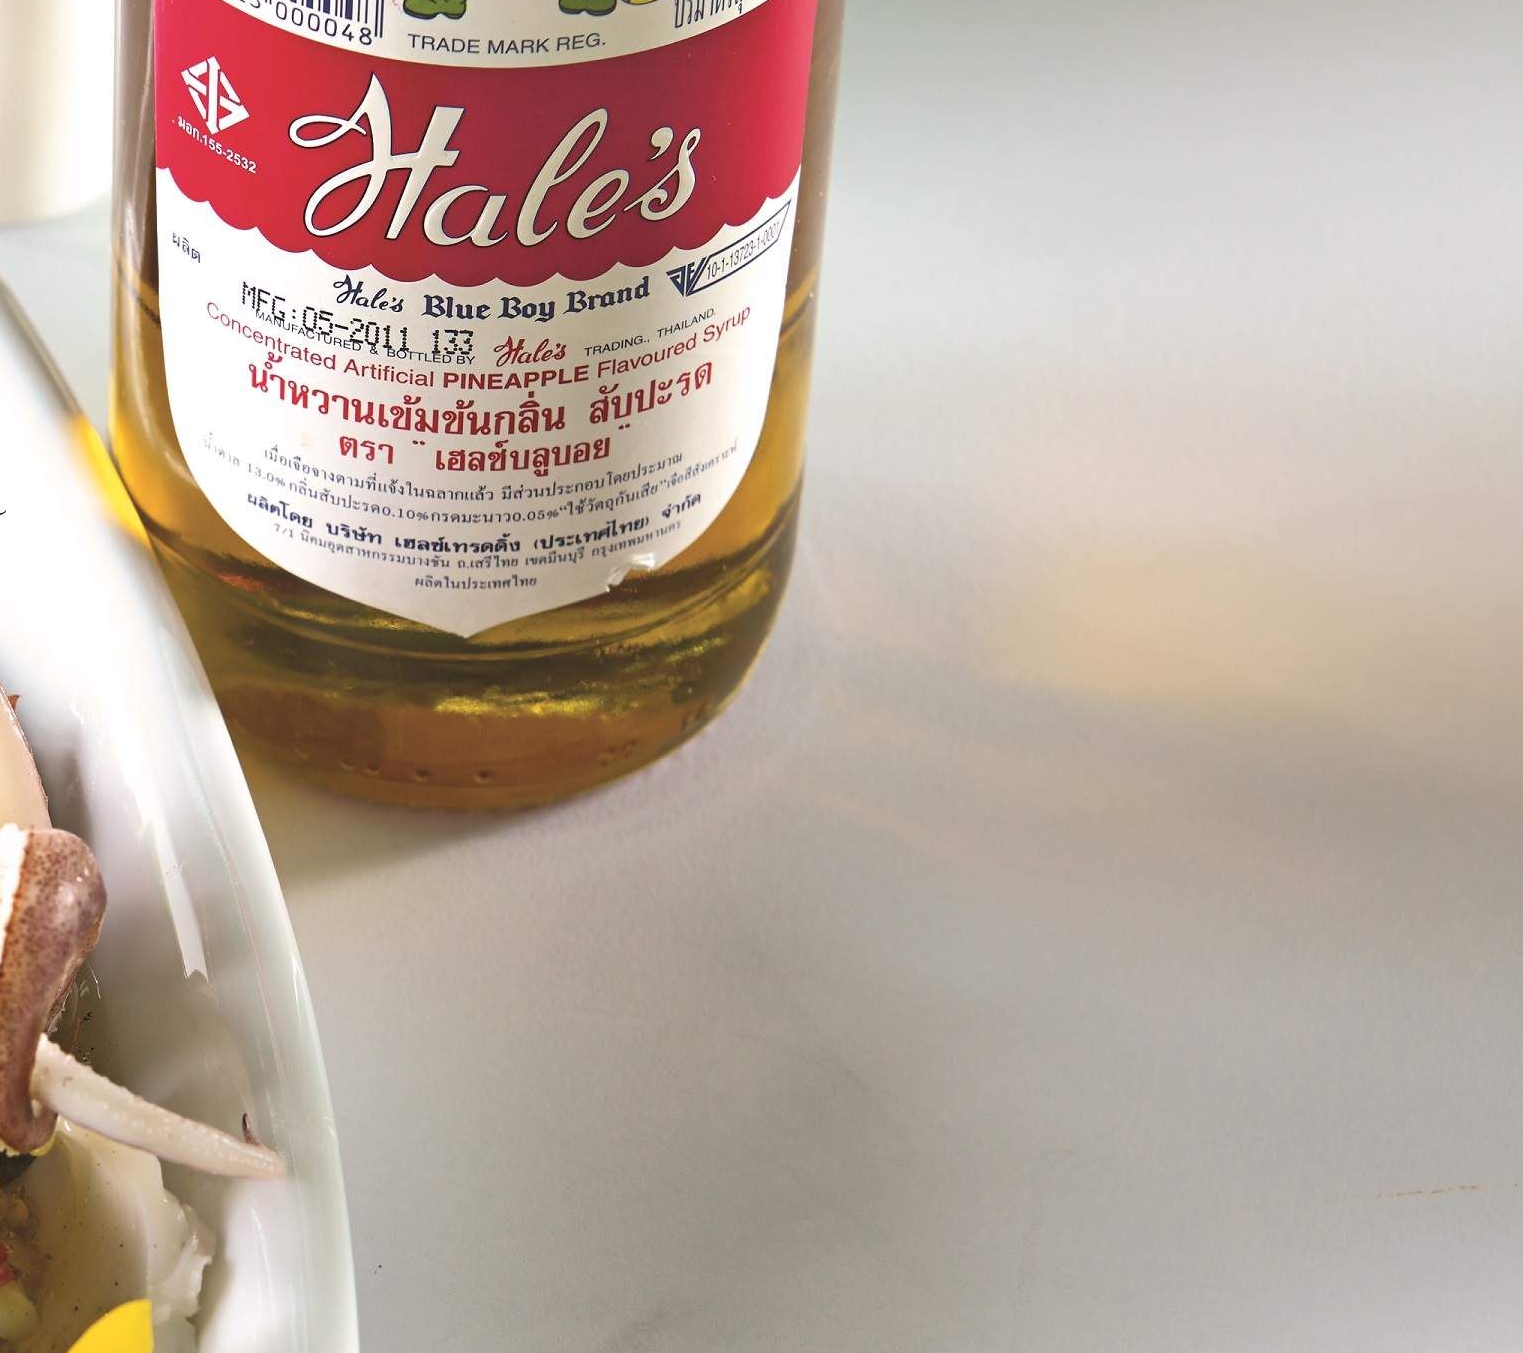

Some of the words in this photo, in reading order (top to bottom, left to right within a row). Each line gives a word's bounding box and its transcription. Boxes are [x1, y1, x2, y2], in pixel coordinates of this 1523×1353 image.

[275, 1, 373, 46] 000048
[407, 33, 481, 55] TRADE
[487, 37, 551, 56] MARK
[556, 32, 607, 52] REG.
[177, 115, 258, 174] มอก.155-2532
[288, 70, 702, 247] Hale's
[172, 232, 201, 263] ผลิต
[707, 219, 780, 280] 10-1-13723-1-0001
[332, 274, 404, 313] Hale's
[422, 294, 491, 321] Blue
[497, 296, 556, 323] Boy
[563, 276, 651, 316] Brand
[206, 301, 337, 370] Concentrated
[343, 358, 435, 387] Artificial
[442, 365, 590, 390] PINEAPPLE
[597, 334, 697, 379] Flavoured
[703, 305, 751, 344] Syrup
[255, 309, 362, 352] MANUFACTURED
[369, 345, 379, 356] &
[386, 347, 452, 364] BOTTLED
[456, 355, 476, 366] BY
[493, 335, 567, 368] Hale's
[656, 308, 716, 339] THAILAND.
[431, 328, 474, 356] 133
[248, 351, 566, 437] น้ำหวานเข้มข้นกลิ่น
[588, 361, 714, 425] สับปะรด
[339, 434, 394, 465] ตรา
[247, 492, 313, 528] ผลิตโดย
[326, 522, 382, 545] บริษัท
[533, 516, 650, 551] (ประเทศไทย)
[661, 492, 702, 520] จำกัด
[414, 573, 537, 590] ผลิตในประเทศไทย
